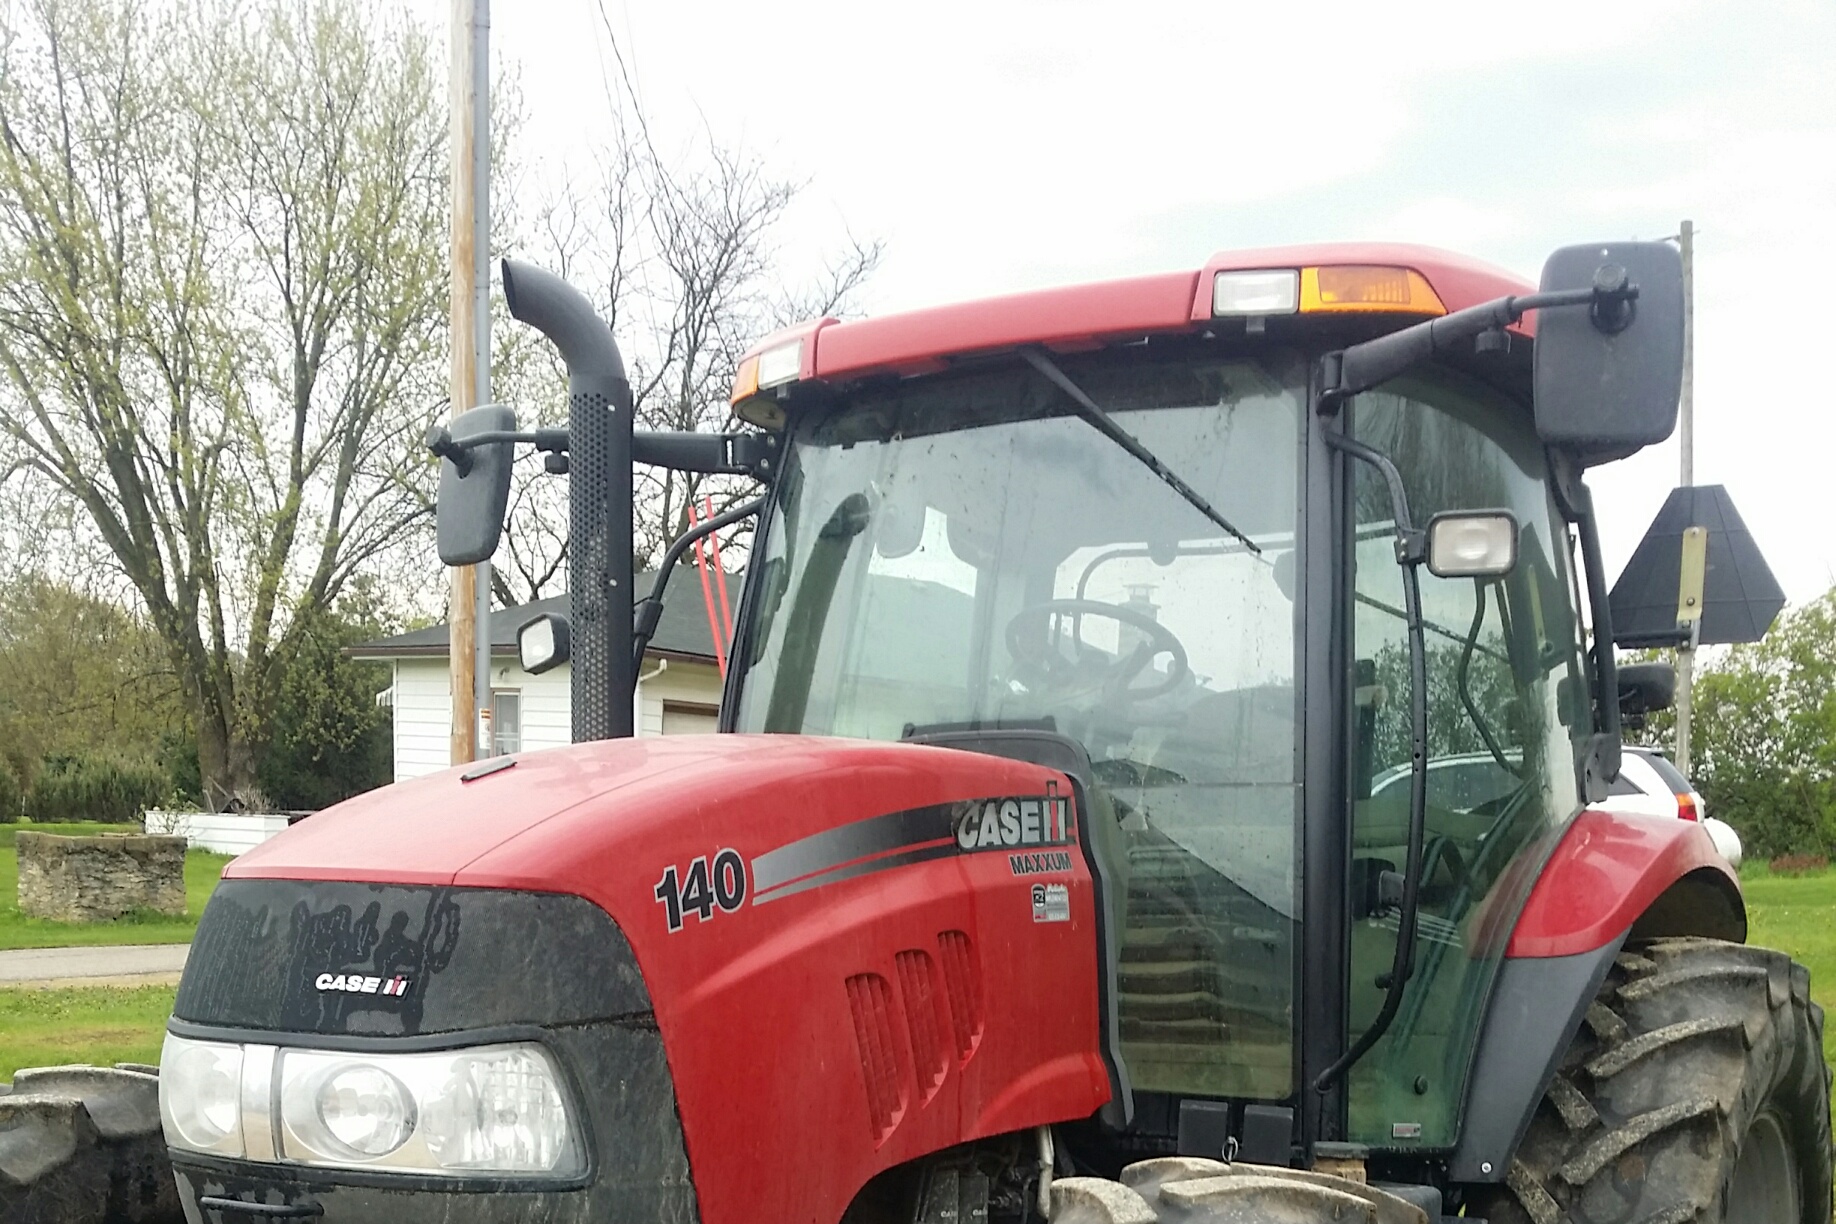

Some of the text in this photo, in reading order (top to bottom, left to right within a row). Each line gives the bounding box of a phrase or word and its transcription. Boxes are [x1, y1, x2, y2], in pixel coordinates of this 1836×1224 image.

[957, 799, 1041, 849] CASE
[1008, 851, 1073, 876] MAXXUM
[654, 847, 746, 934] 140
[315, 973, 382, 994] CASE
